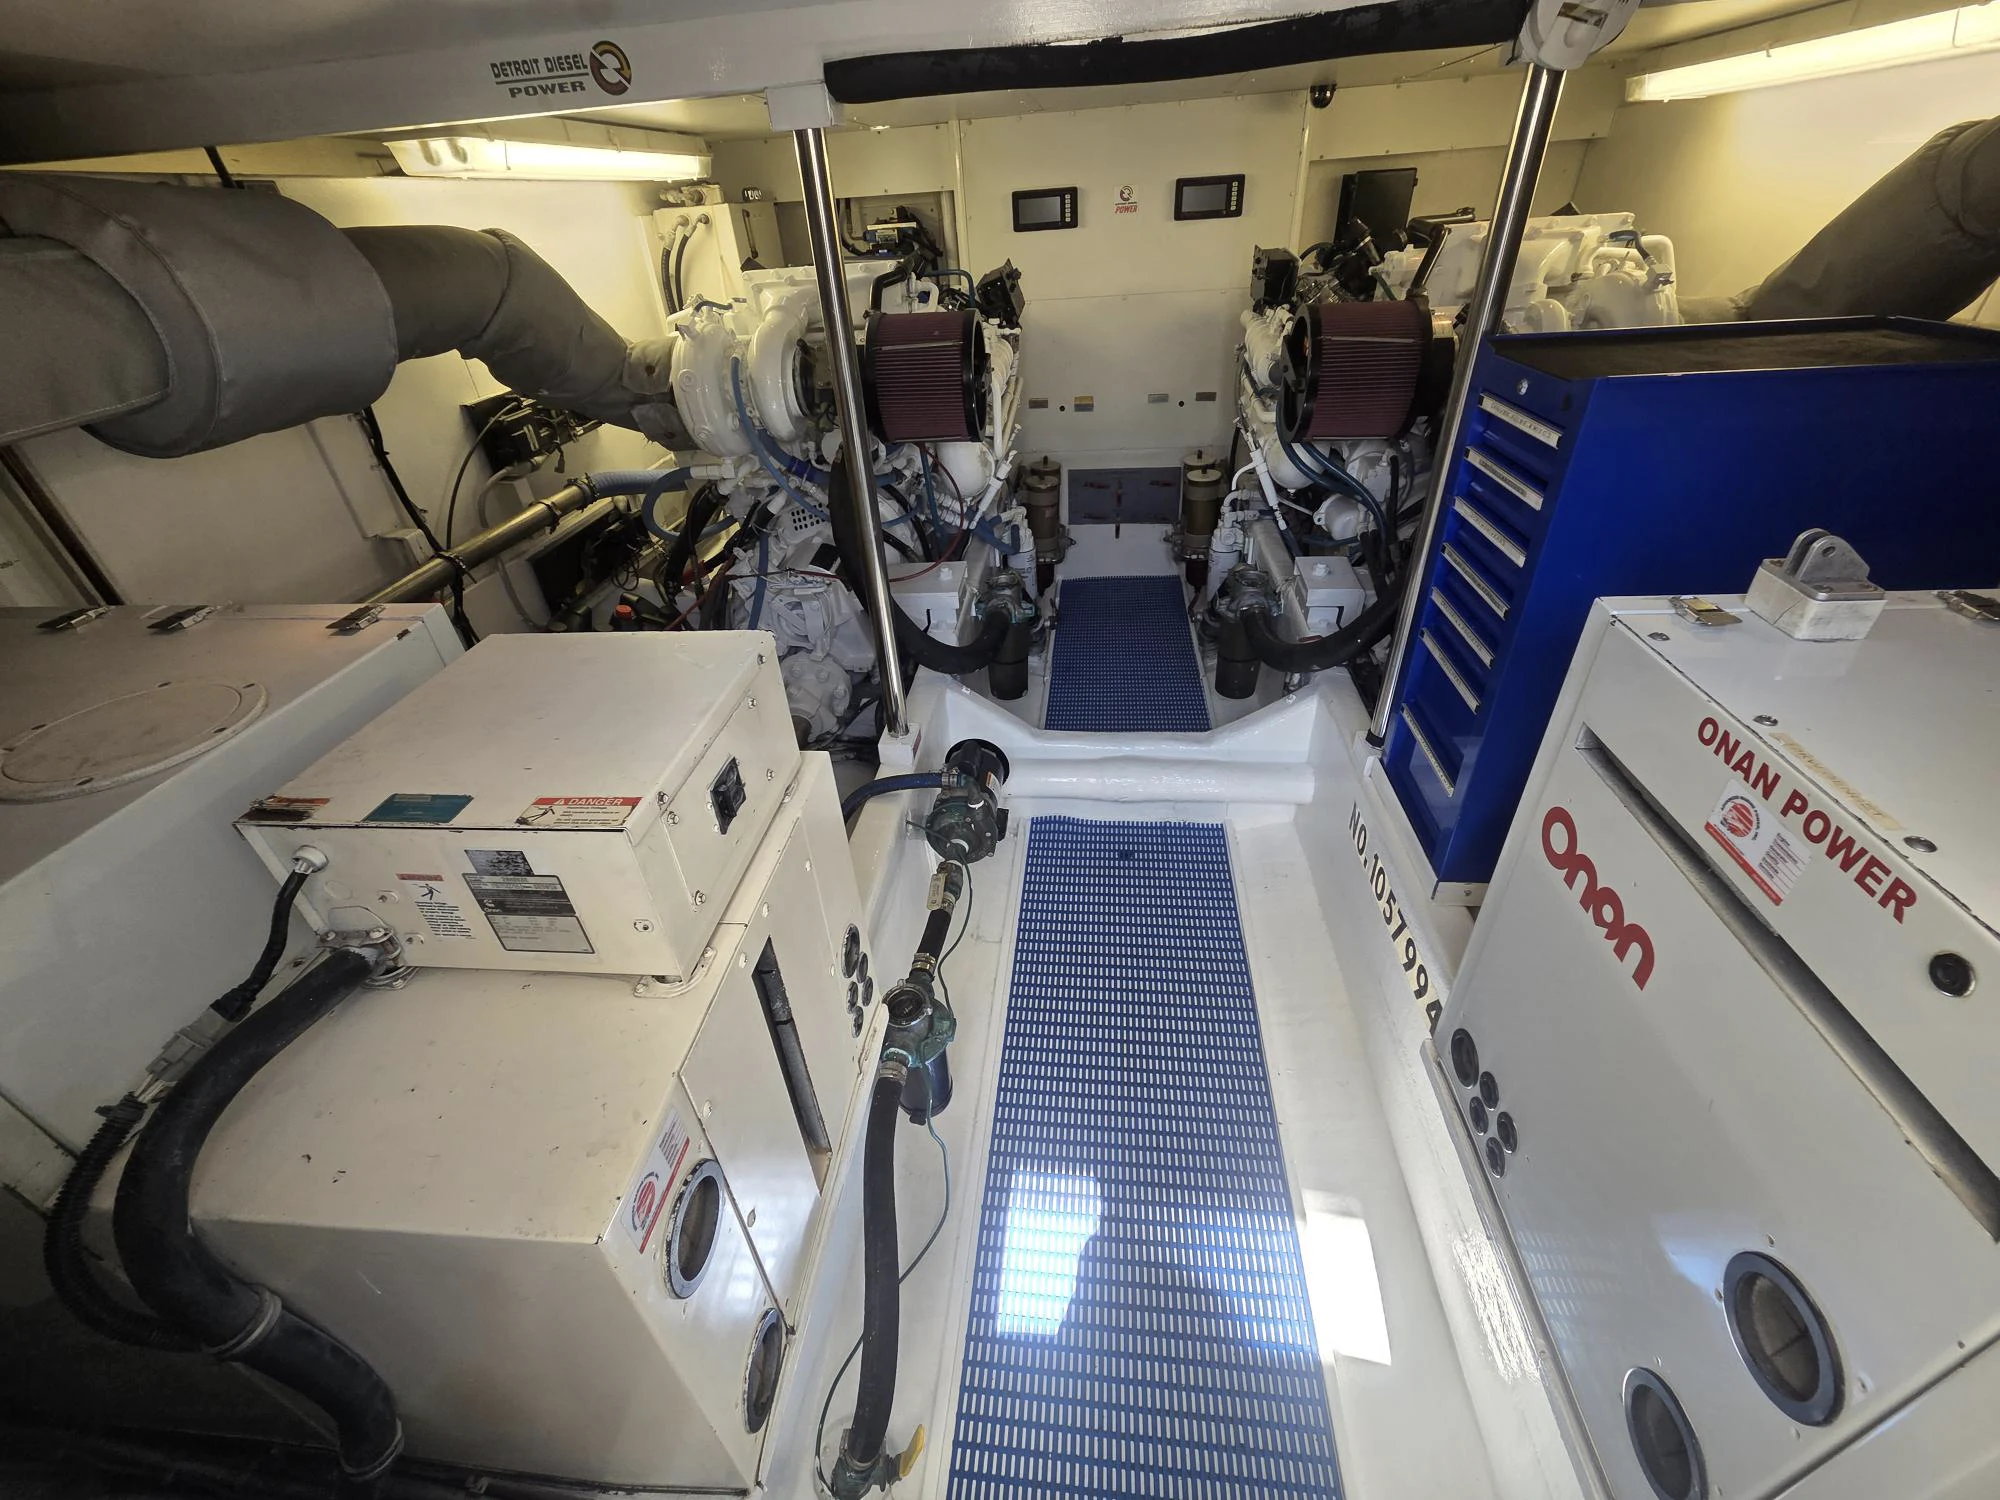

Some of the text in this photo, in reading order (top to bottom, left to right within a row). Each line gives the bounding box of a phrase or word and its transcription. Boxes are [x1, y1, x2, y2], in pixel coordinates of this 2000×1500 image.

[490, 53, 588, 79] DETROIT DIESEL
[508, 80, 586, 98] POWER
[1115, 205, 1138, 213] POWER
[567, 798, 624, 806] DANGER
[1697, 717, 1782, 801] ONAN
[1780, 788, 1918, 925] POWER
